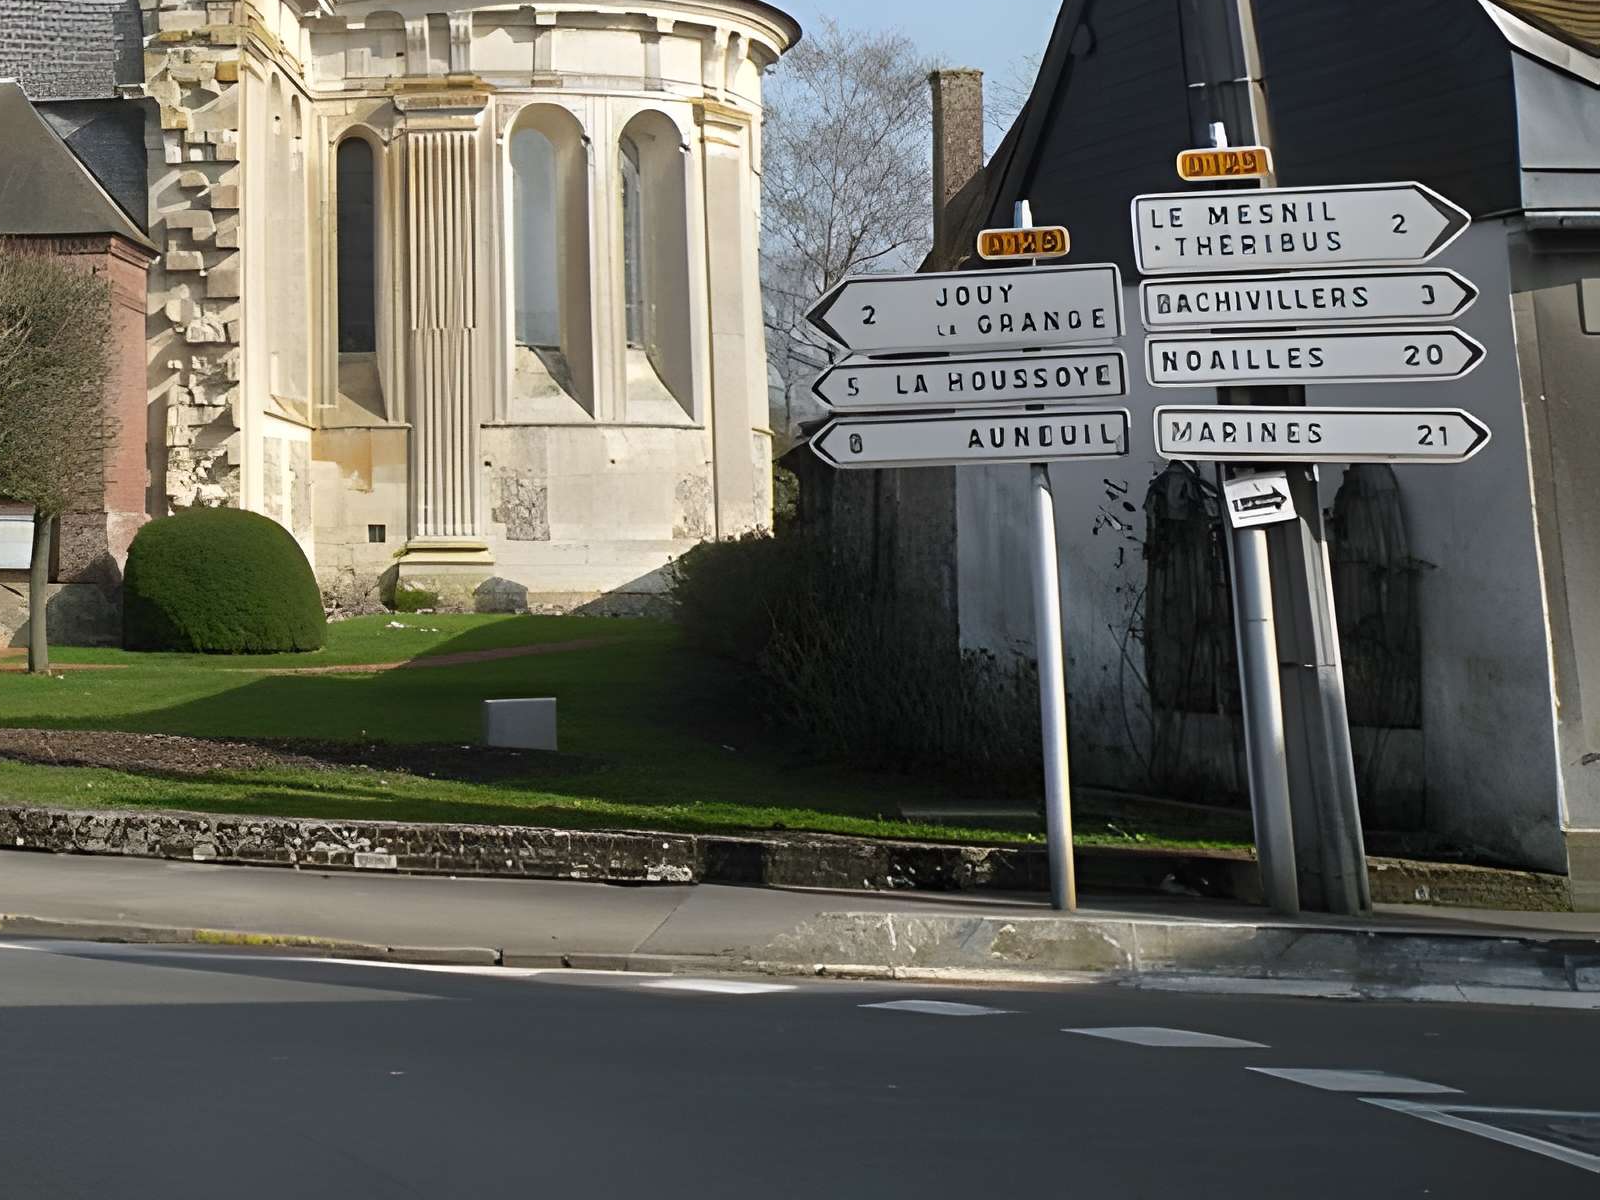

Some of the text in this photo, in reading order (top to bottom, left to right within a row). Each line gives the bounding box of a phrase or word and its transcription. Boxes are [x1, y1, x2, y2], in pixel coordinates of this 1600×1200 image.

[1151, 202, 1336, 228] LE MESNIL
[1391, 214, 1407, 234] 2
[936, 284, 1013, 307] JOUY
[1157, 286, 1369, 314] BACHIVILLERS
[862, 305, 876, 325] 2
[1162, 344, 1443, 372] NOAILLES 20
[847, 364, 1111, 396] 5 LA HOUSSOYE
[1172, 421, 1447, 446] MARINES 21
